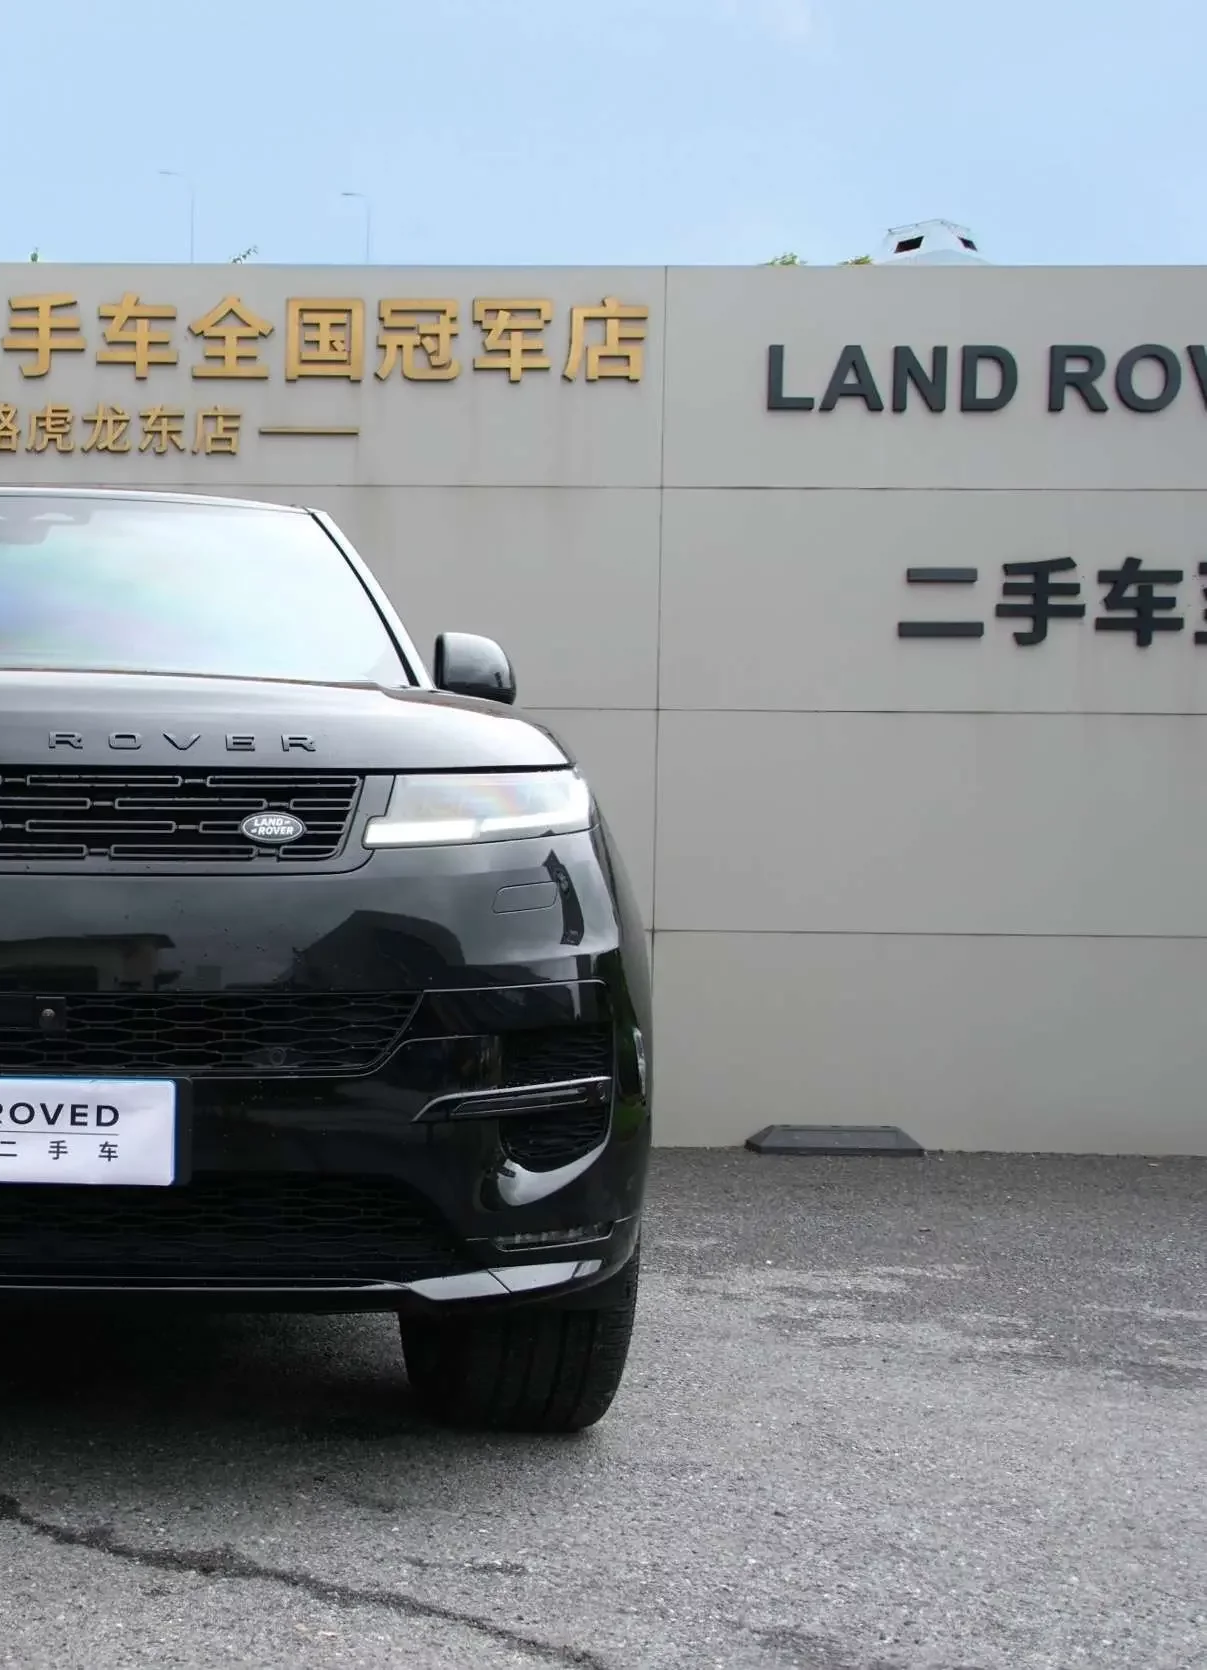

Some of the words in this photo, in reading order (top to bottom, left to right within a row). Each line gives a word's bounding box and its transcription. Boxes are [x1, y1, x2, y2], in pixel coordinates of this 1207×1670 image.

[767, 344, 1019, 413] LAND
[898, 556, 1207, 647] 二手车
[49, 730, 316, 753] ROVER
[254, 818, 283, 827] LAND
[258, 826, 294, 835] ROVER
